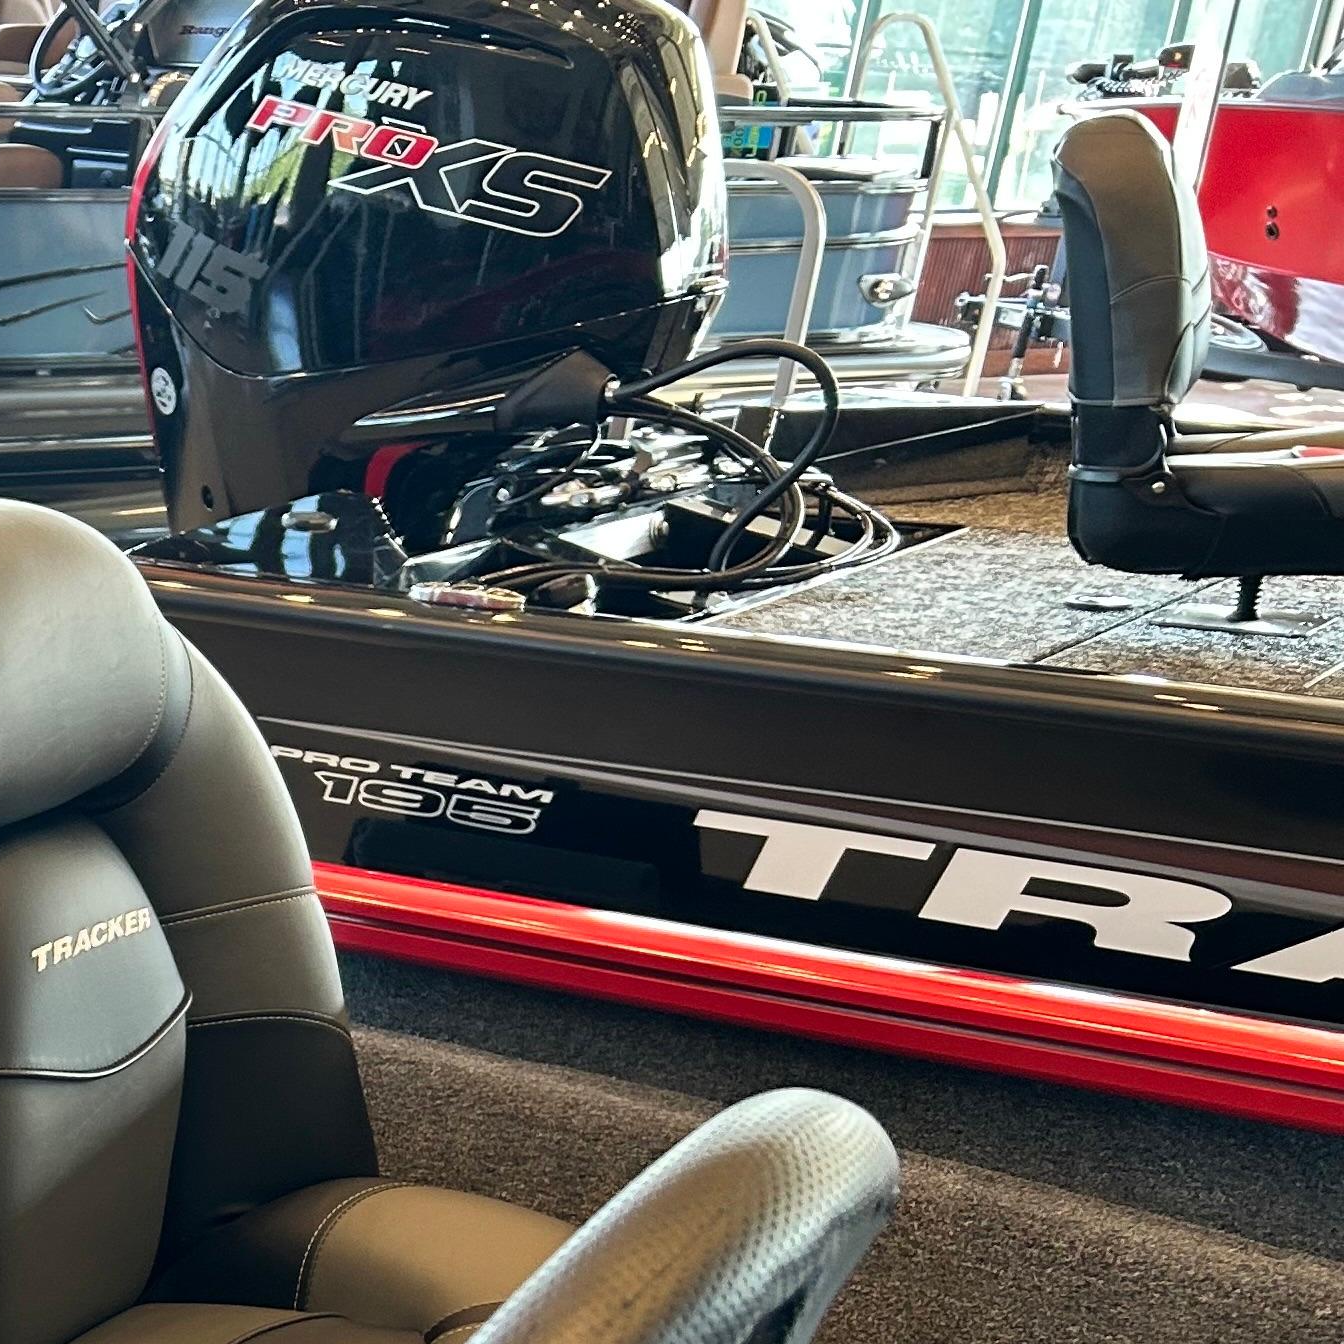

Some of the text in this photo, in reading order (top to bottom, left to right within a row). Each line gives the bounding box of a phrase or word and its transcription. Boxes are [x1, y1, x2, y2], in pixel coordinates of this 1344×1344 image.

[179, 25, 230, 38] Rang
[280, 60, 433, 111] MERCURY
[246, 95, 612, 237] PRO XS
[158, 219, 269, 313] 115
[270, 745, 555, 803] PRO TEAM
[31, 907, 151, 972] TRACKER
